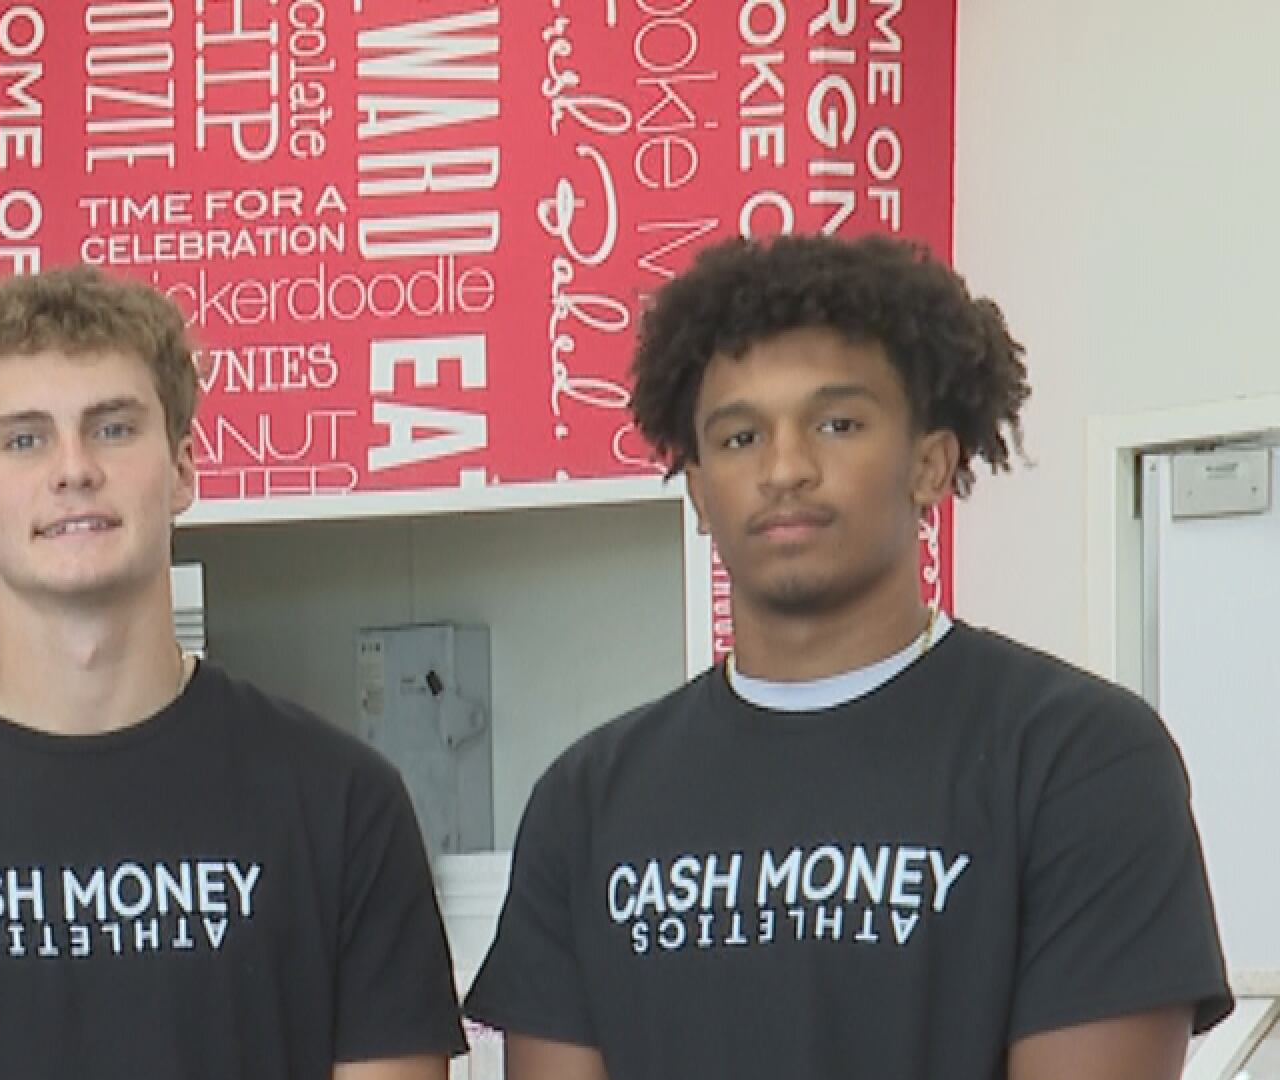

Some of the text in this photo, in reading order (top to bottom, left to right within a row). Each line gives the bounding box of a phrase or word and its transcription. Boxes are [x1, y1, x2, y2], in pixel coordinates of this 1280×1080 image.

[83, 0, 175, 174] OOZIE
[195, 0, 280, 162] HIP
[287, 0, 337, 160] colate
[354, 0, 501, 260] WARD
[738, 0, 788, 171] OKIE
[866, 0, 904, 233] ME OF
[79, 185, 348, 229] TIME FOR A
[79, 222, 346, 265] CELEBRATION
[164, 254, 496, 329] ckerdoodle
[60, 859, 262, 923] MONEY
[607, 844, 972, 923] CASH MONEY
[631, 904, 920, 955] ATHLETICS
